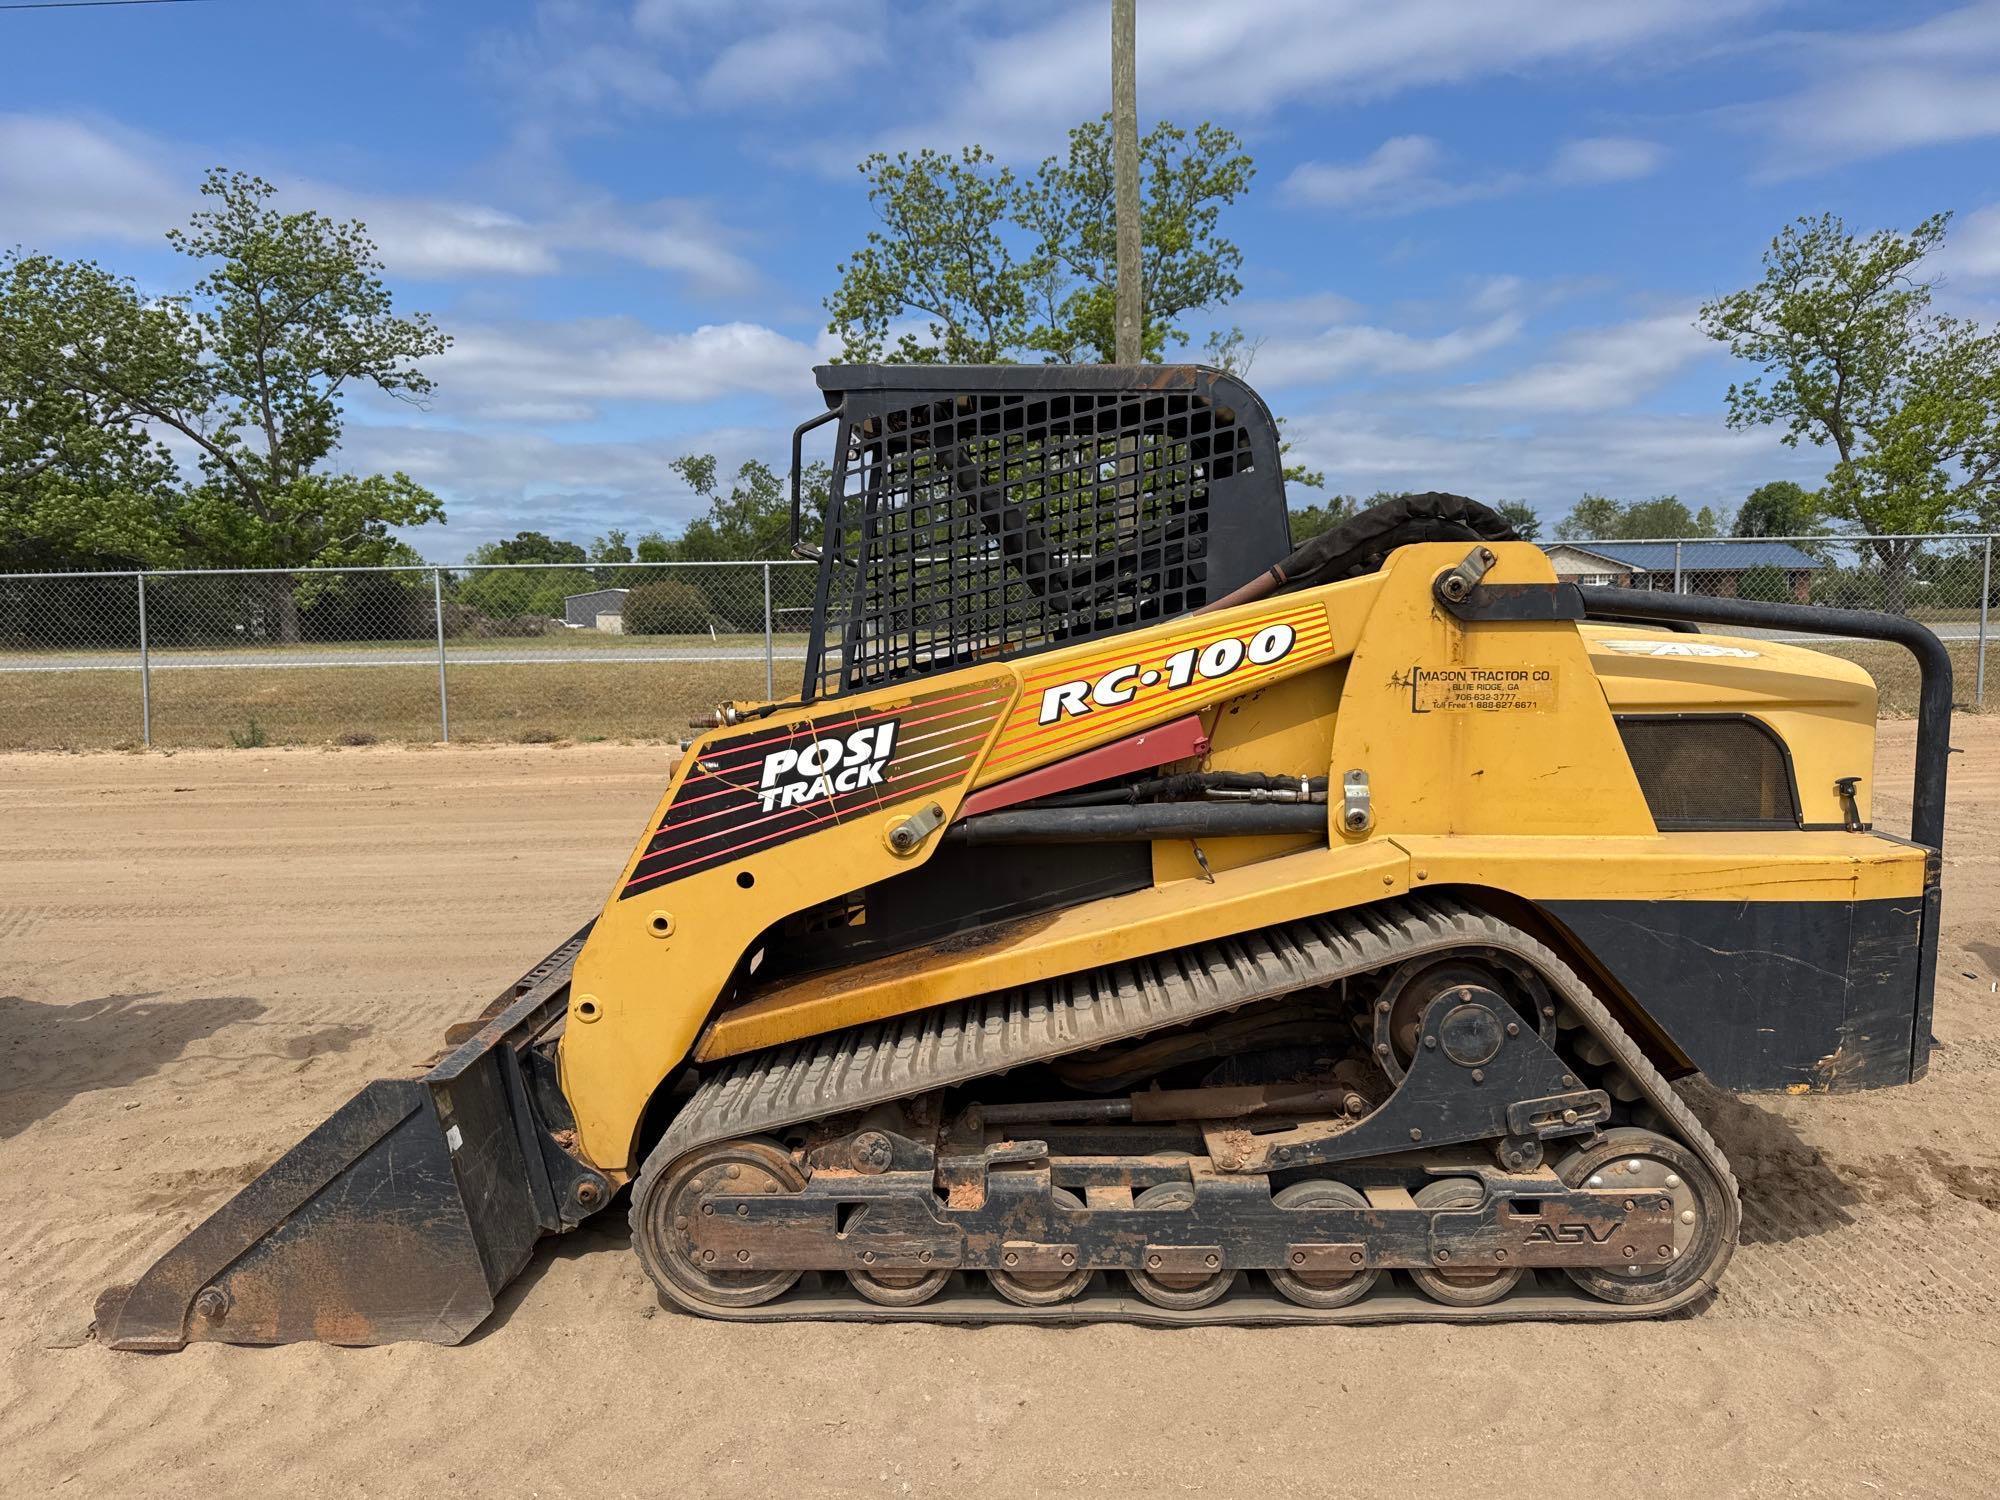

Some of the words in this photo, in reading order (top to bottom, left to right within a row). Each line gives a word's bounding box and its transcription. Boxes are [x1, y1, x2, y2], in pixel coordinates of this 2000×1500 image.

[1419, 671, 1466, 681] MASON
[1470, 671, 1528, 681] TRACTOR
[1532, 671, 1552, 681] CO.
[1452, 683, 1474, 691] BLUE
[1507, 683, 1519, 691] GA
[1455, 693, 1516, 701] 706-632-3777
[1432, 701, 1447, 709] Toll
[1448, 701, 1466, 709] Free
[760, 721, 896, 789] POSI
[757, 759, 887, 813] TRACK
[1523, 1223, 1622, 1246] ASV
